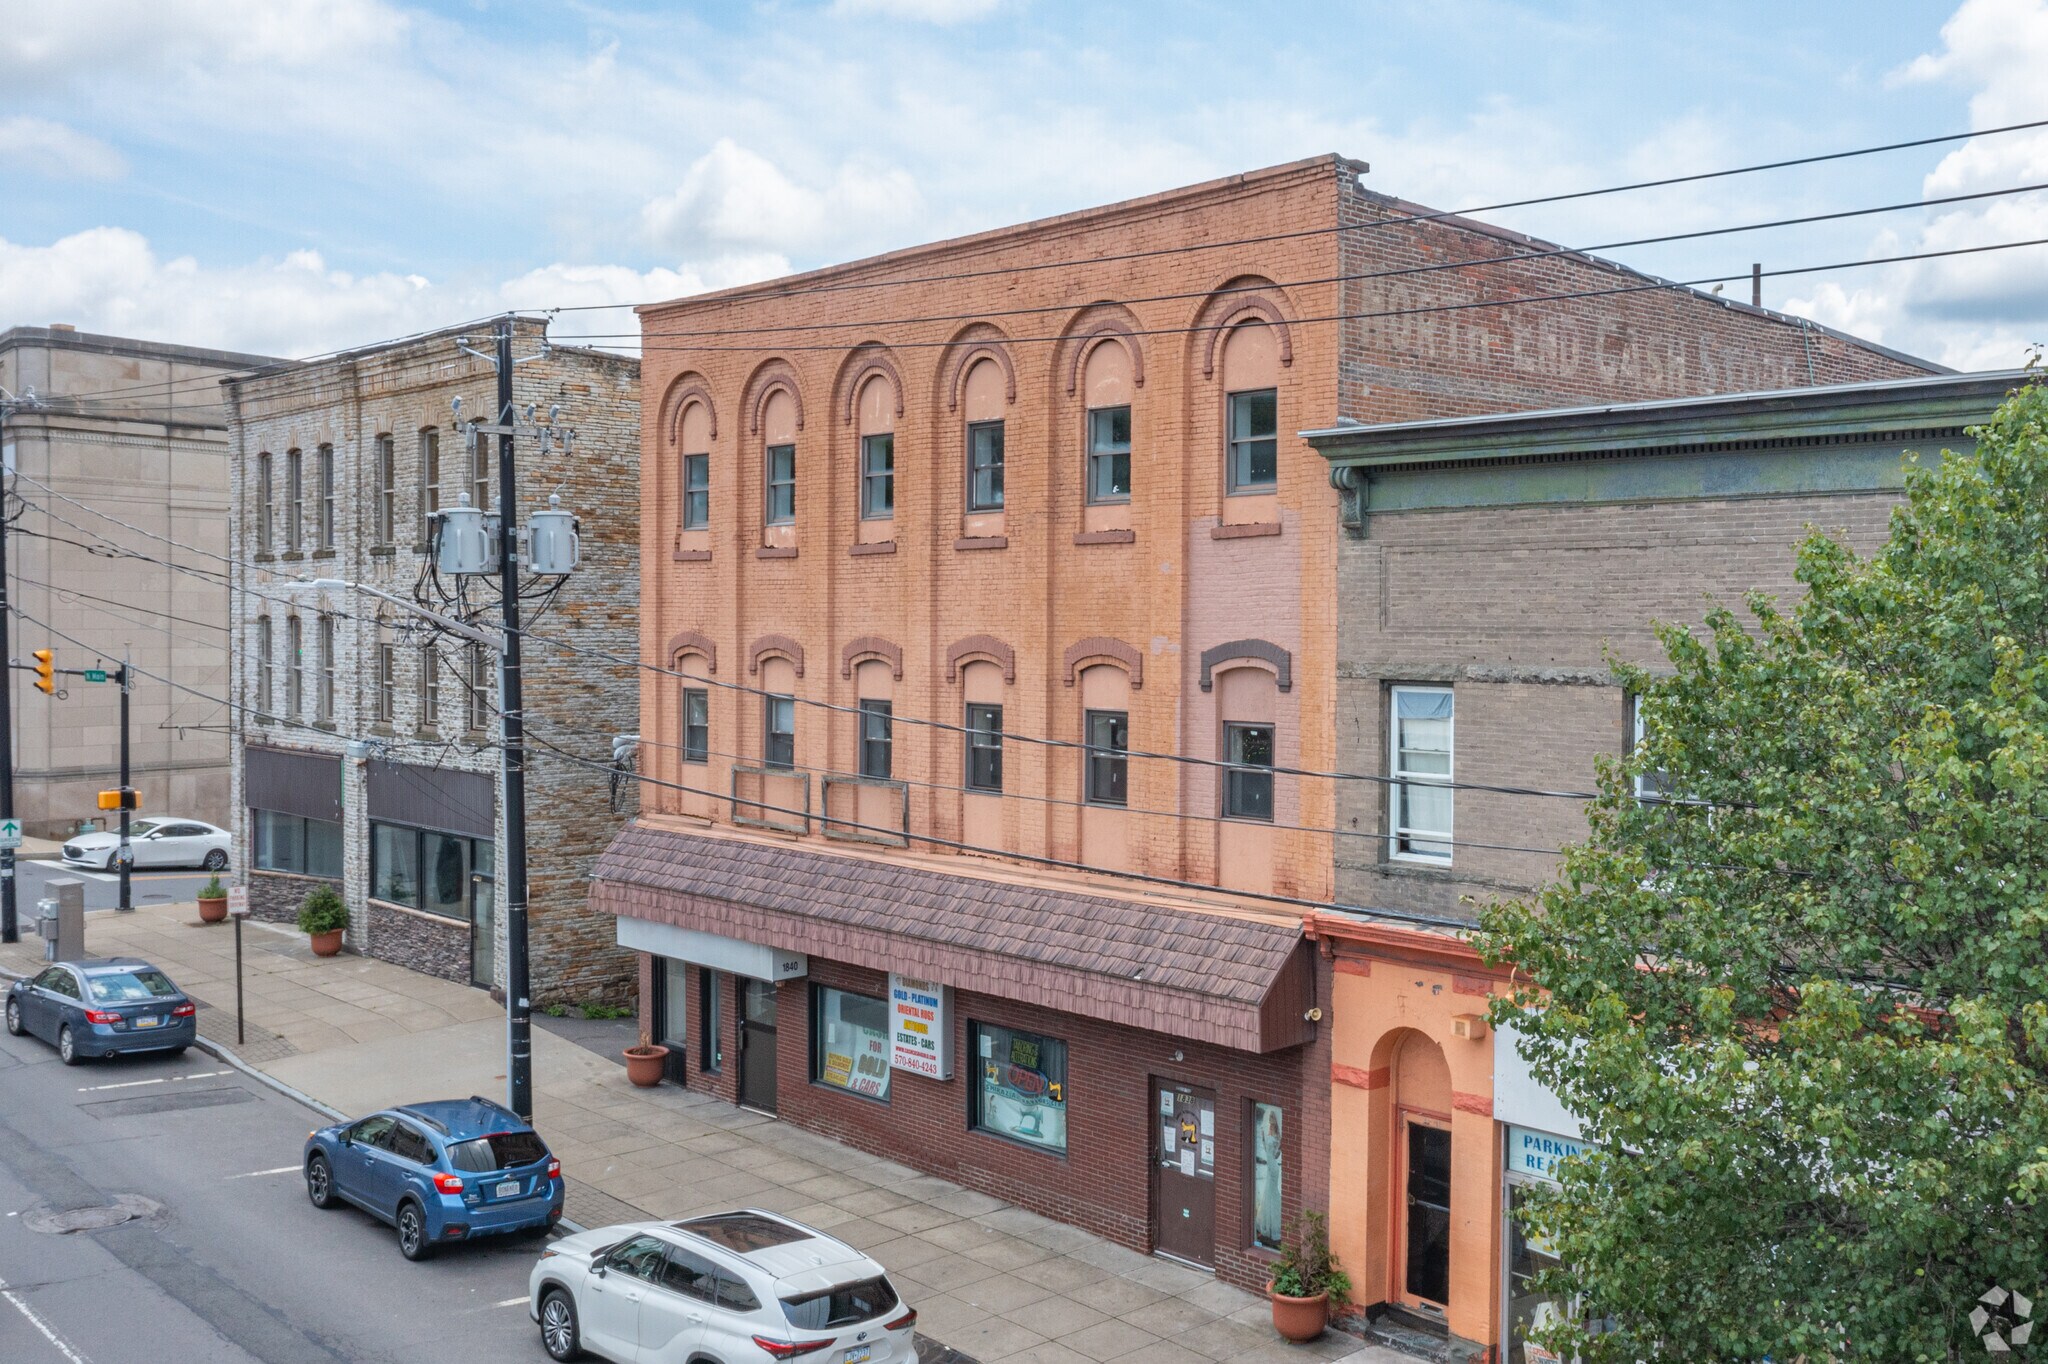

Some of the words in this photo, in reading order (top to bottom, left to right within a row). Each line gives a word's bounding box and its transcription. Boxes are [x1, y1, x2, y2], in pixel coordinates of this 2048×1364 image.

[91, 672, 105, 681] Main
[782, 961, 799, 973] 1840
[893, 988, 908, 1001] GOLD
[911, 993, 938, 1009] PLATINUM
[897, 1003, 920, 1018] ORIENTAL
[921, 1008, 935, 1021] RUGS
[869, 1040, 882, 1054] FOR
[897, 1032, 917, 1047] ESTATES
[921, 1038, 935, 1051] CARS
[858, 1053, 888, 1079] GOLD
[895, 1054, 937, 1075] 570-840-4243
[851, 1077, 859, 1090] &
[859, 1078, 881, 1097] CARS
[1009, 1065, 1045, 1092] OPEN
[1524, 1135, 1583, 1158] PARKIN
